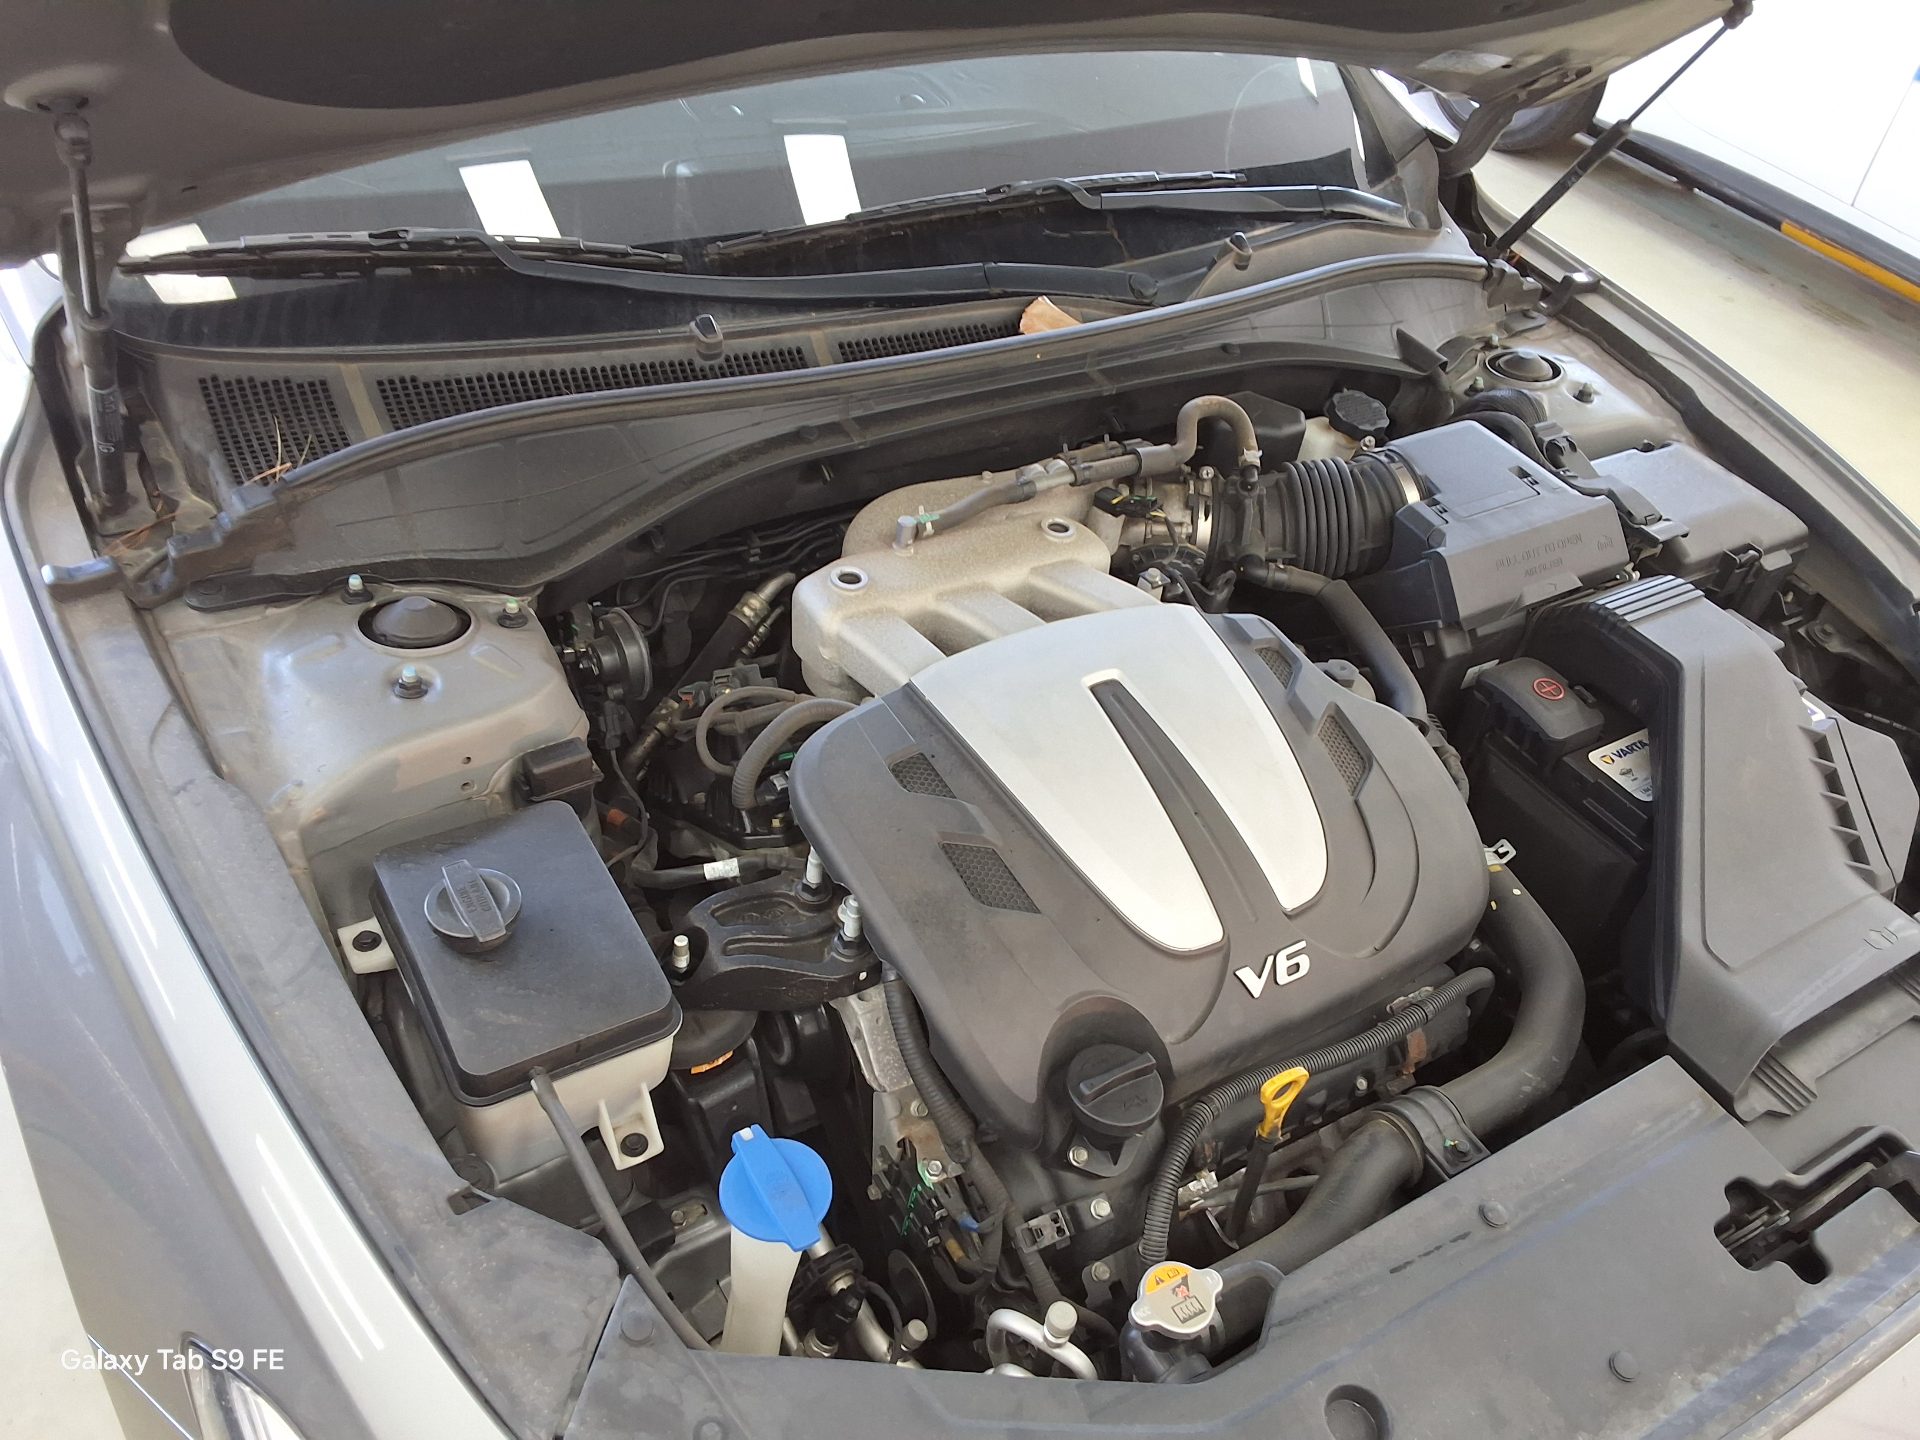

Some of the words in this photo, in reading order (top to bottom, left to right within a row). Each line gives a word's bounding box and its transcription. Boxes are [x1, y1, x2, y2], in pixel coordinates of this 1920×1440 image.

[1522, 547, 1541, 561] OUT
[1544, 542, 1556, 553] TO
[1611, 739, 1649, 759] VARTA
[1234, 939, 1310, 999] V6
